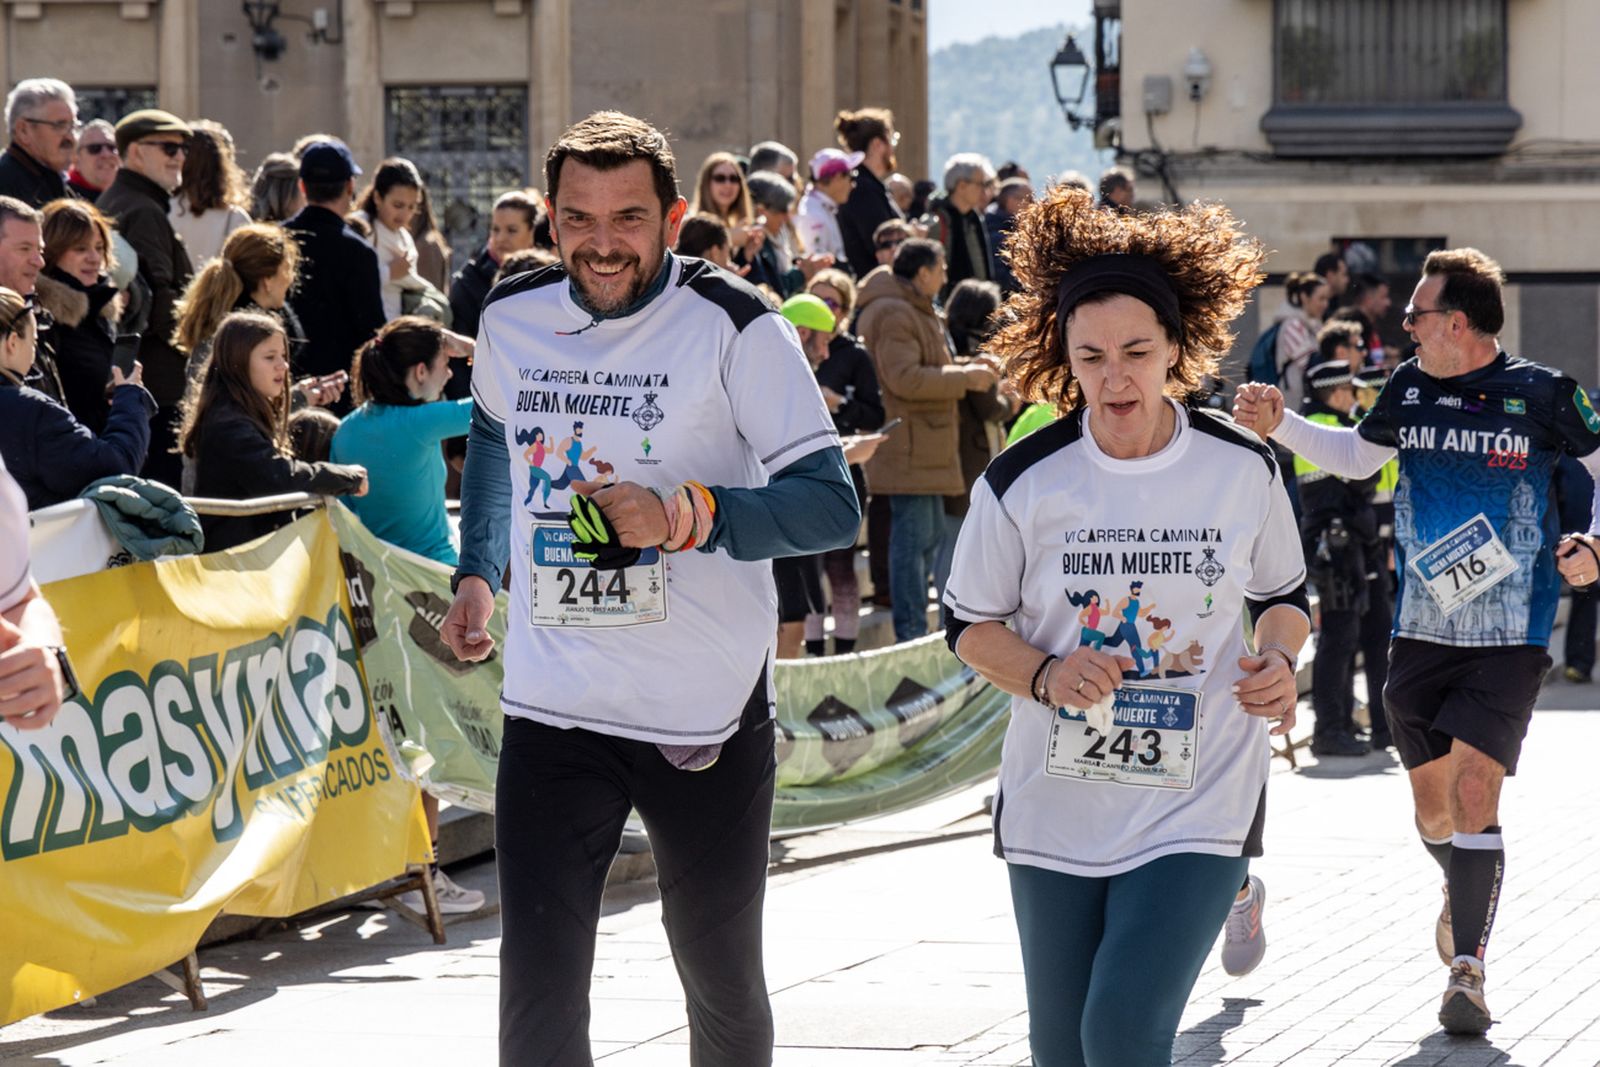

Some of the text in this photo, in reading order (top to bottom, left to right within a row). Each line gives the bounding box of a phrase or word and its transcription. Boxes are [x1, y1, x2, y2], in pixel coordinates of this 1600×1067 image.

[519, 368, 669, 387] VI CARRERA CAMINATA
[516, 390, 632, 417] BUENA MUERTE
[1399, 426, 1530, 458] SAN ANTÓN
[1487, 450, 1528, 470] 2025
[1065, 528, 1222, 543] VI CARRERA CAMINATA
[544, 547, 574, 562] BUENA
[1063, 552, 1192, 575] BUENA MUERTE
[1444, 554, 1486, 591] 716
[556, 568, 631, 605] 244
[1132, 692, 1181, 705] CAMINATA
[1113, 706, 1157, 724] MUERTE
[1083, 726, 1162, 766] 243
